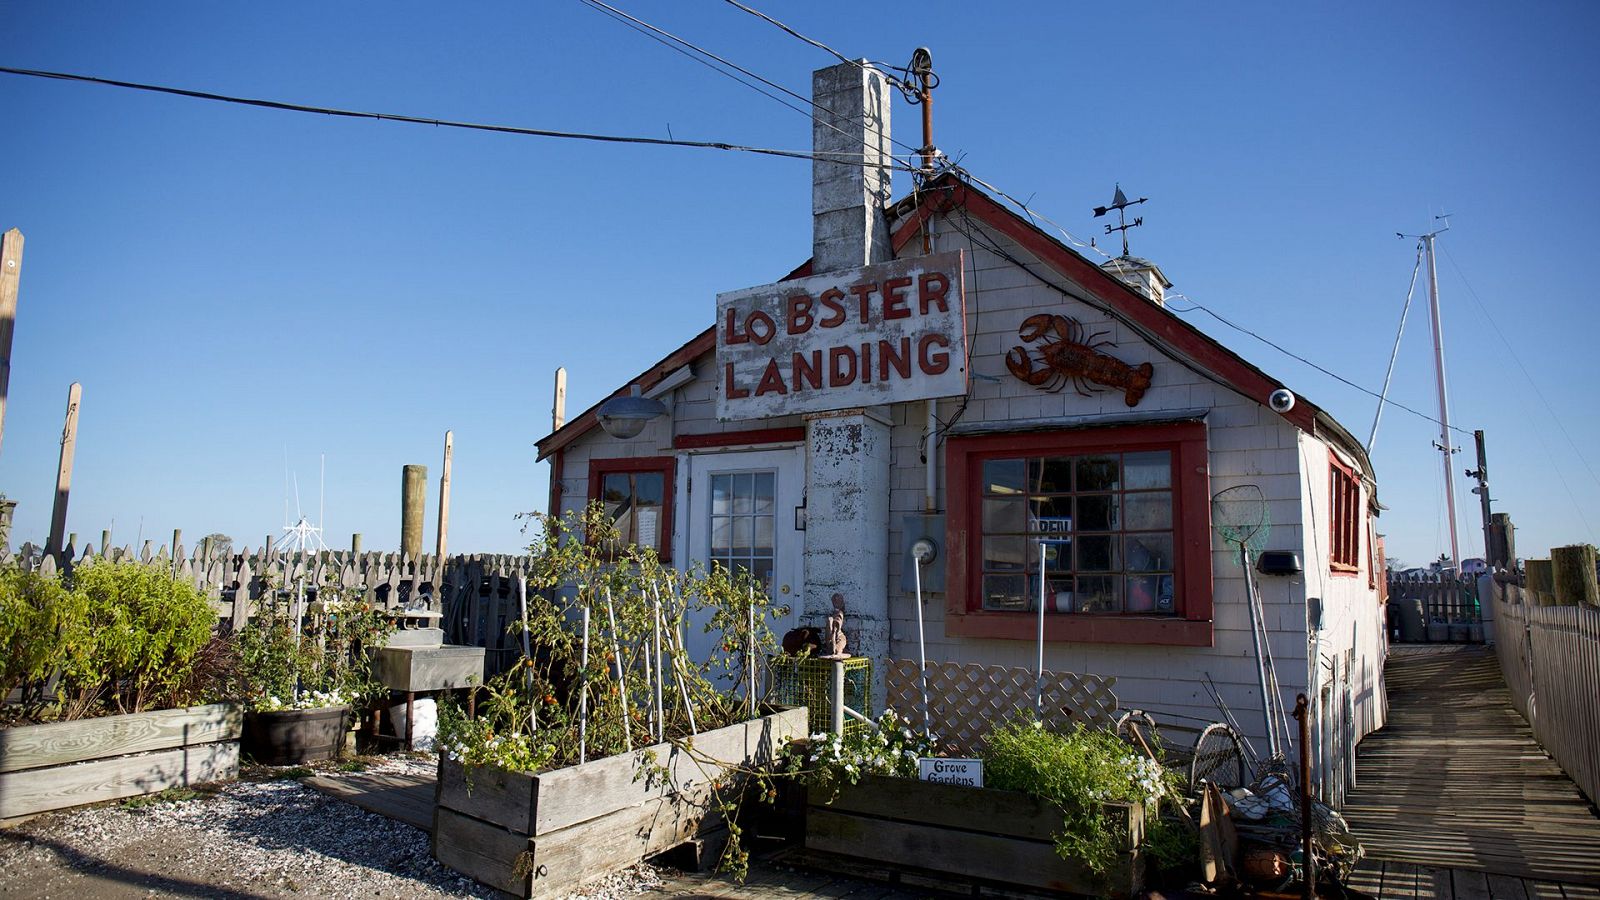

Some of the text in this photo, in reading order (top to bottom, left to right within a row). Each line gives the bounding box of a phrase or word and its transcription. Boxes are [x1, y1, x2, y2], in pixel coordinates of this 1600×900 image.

[726, 271, 950, 346] LOBSTER
[726, 333, 950, 400] LANDING
[928, 772, 974, 786] Gardens
[934, 760, 967, 773] Grove
